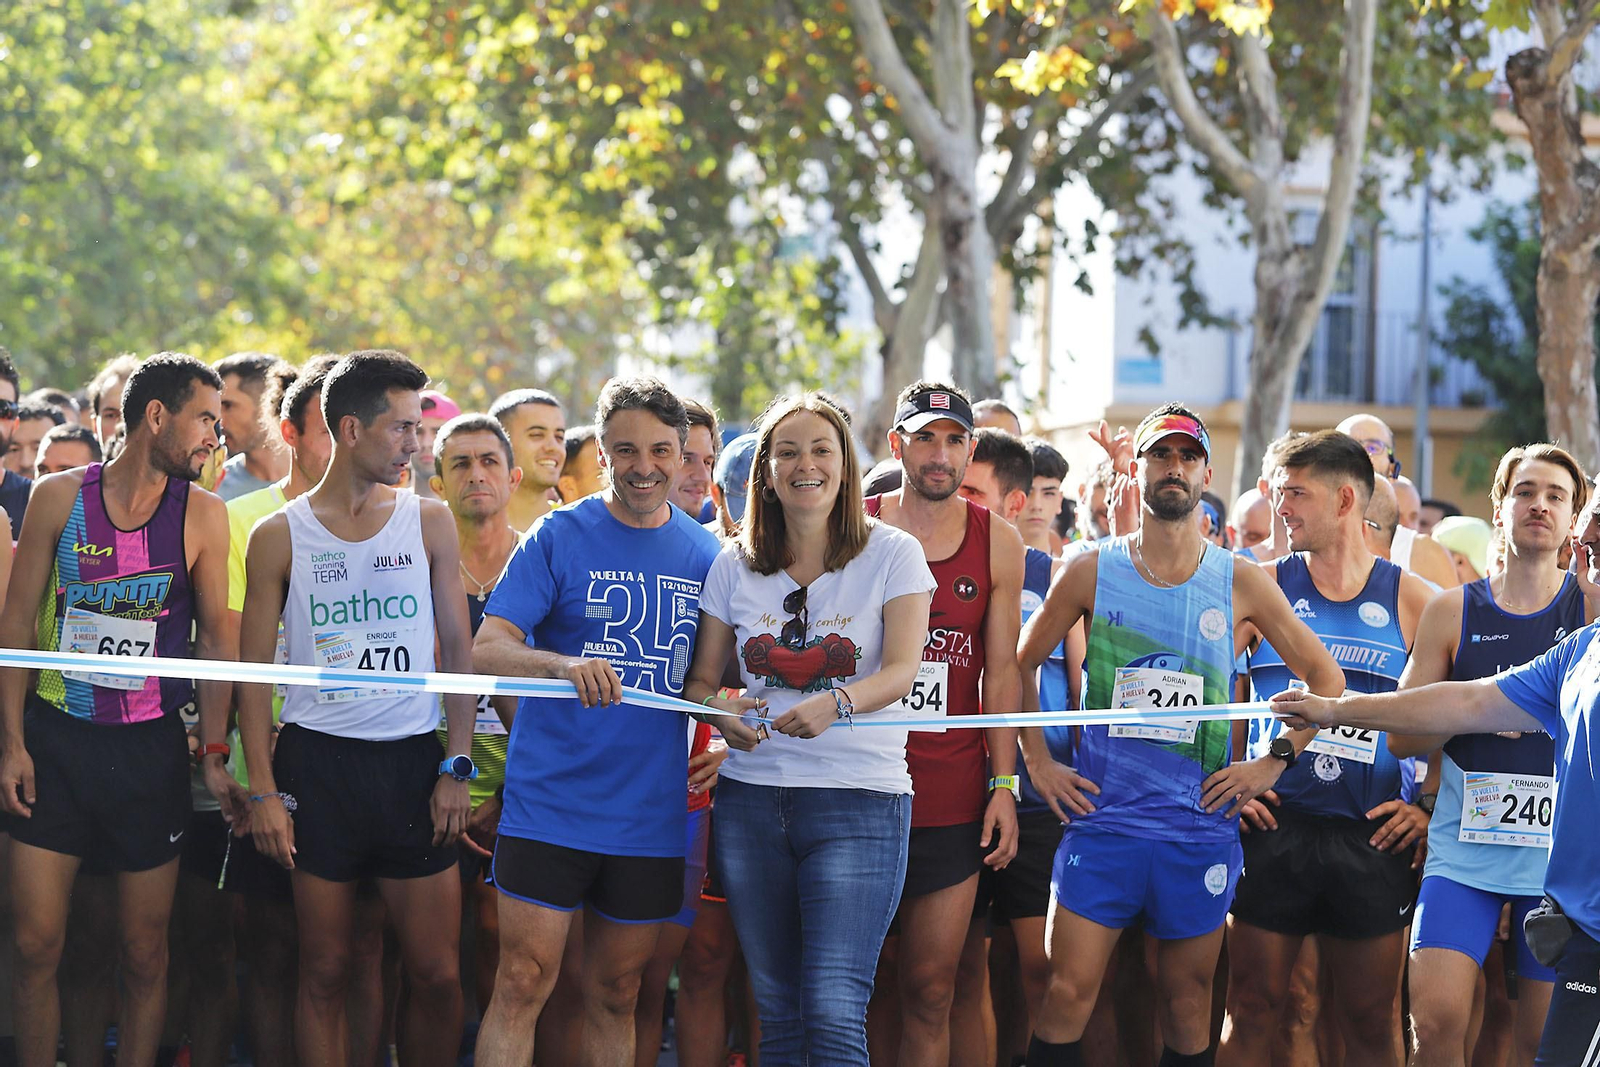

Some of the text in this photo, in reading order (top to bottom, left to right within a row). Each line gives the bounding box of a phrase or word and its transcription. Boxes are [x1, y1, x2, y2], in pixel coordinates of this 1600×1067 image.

[311, 551, 346, 562] bathco
[373, 552, 412, 568] JULIÁN
[314, 561, 345, 570] running
[312, 568, 348, 583] TEAM
[589, 570, 645, 582] VUELTA A
[662, 581, 699, 594] 12/10/22
[309, 589, 418, 627] bathco
[752, 613, 777, 627] Me
[816, 613, 854, 630] contigo
[80, 625, 97, 633] VUELTA
[79, 633, 98, 641] HUELVA
[366, 631, 397, 641] ENRIQUE
[98, 636, 150, 656] 667
[322, 642, 352, 657] 35 VUELTA
[584, 641, 617, 652] HUELVA
[327, 650, 355, 664] A HUELVA
[357, 645, 410, 673] 470
[1324, 642, 1391, 668] MONTE
[1120, 680, 1144, 692] 35 VUELTA
[1162, 675, 1187, 686] ADRIAN
[901, 681, 942, 711] 54
[1126, 688, 1146, 698] HUELVA
[1511, 779, 1549, 789] FERNANDO
[1471, 785, 1499, 797] 35 VUELTA
[1479, 793, 1500, 803] HUELVA
[1500, 794, 1552, 827] 240
[1565, 981, 1597, 994] adidas
